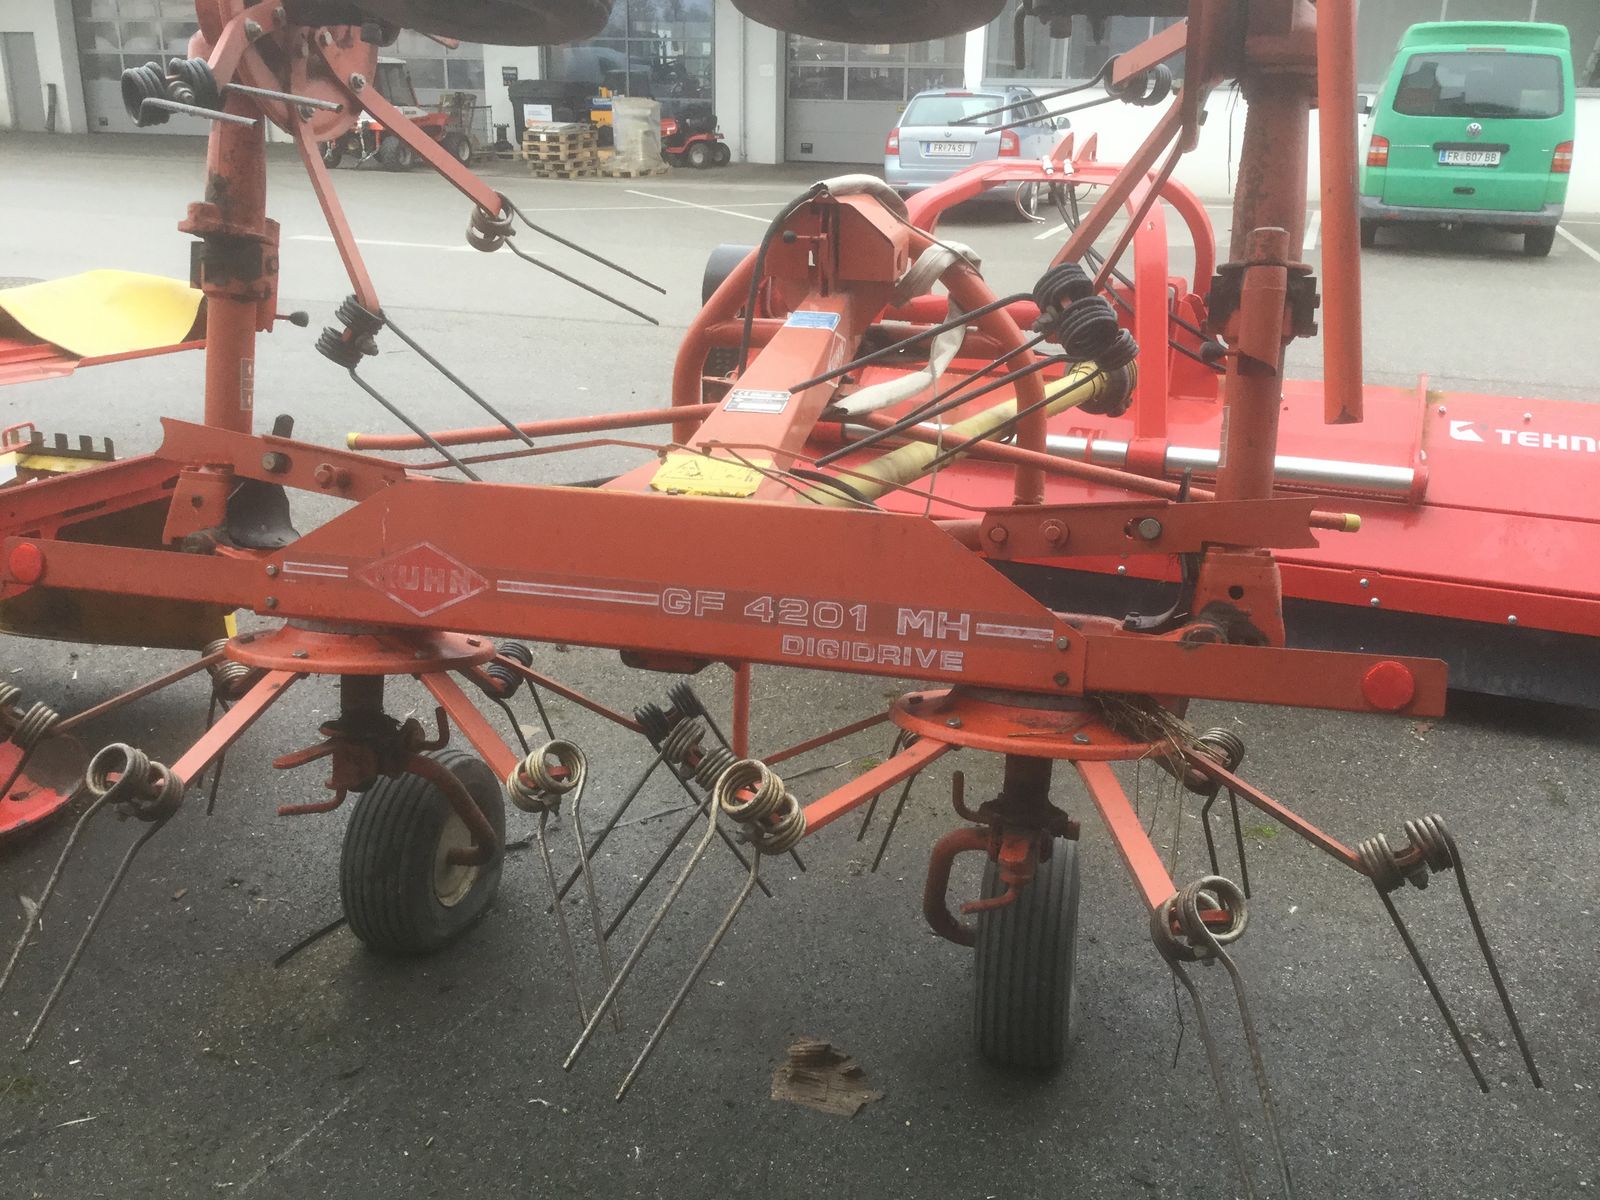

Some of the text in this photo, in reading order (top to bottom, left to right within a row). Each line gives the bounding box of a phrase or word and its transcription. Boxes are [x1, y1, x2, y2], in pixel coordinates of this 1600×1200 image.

[1447, 151, 1459, 161] FR
[1496, 429, 1600, 453] TEHN
[662, 588, 970, 641] GF 4201 MH
[782, 635, 964, 672] DIGIDRIVE
